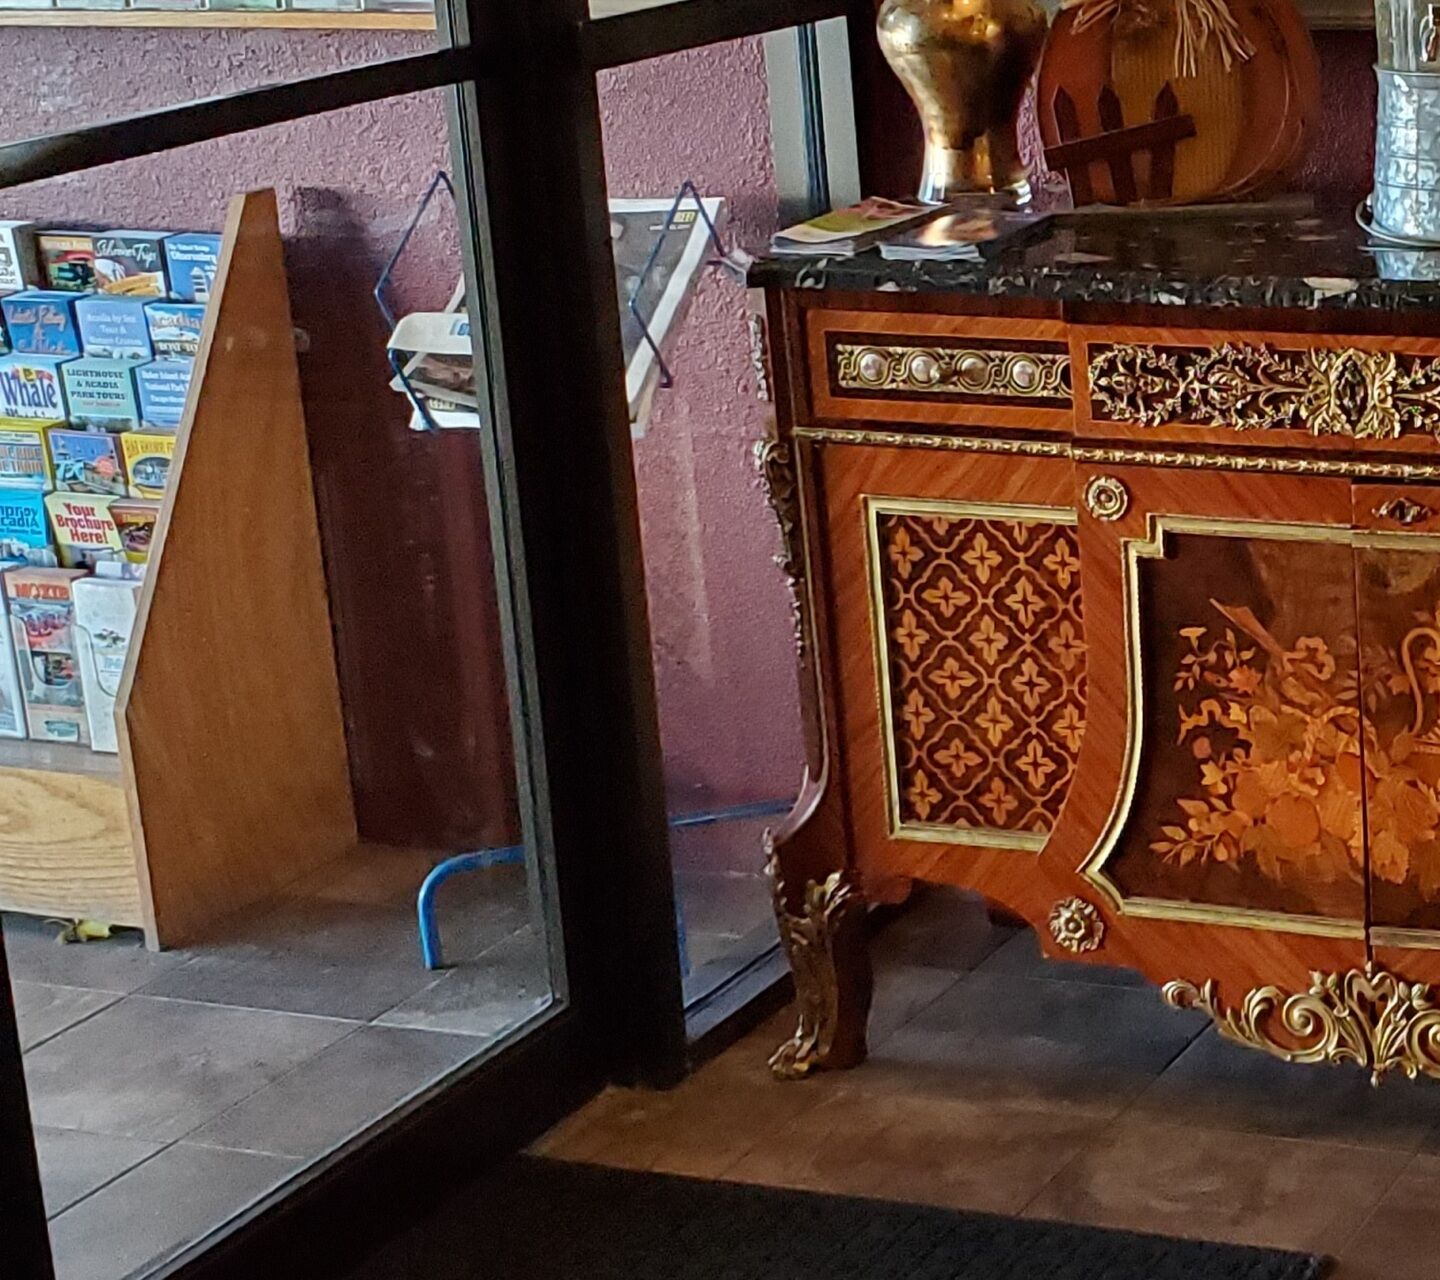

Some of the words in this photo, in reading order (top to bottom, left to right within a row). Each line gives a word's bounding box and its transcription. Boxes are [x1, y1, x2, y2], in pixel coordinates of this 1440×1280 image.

[134, 243, 157, 268] Trips
[66, 369, 125, 379] LIGHTHOUSE
[0, 371, 58, 410] Whale
[85, 381, 119, 389] ACADIA
[70, 391, 95, 399] PARK
[96, 391, 126, 401] TOURS
[63, 502, 97, 516] Your
[56, 514, 114, 531] Brochure
[69, 528, 109, 544] Here!
[14, 583, 69, 603] MOXIE
